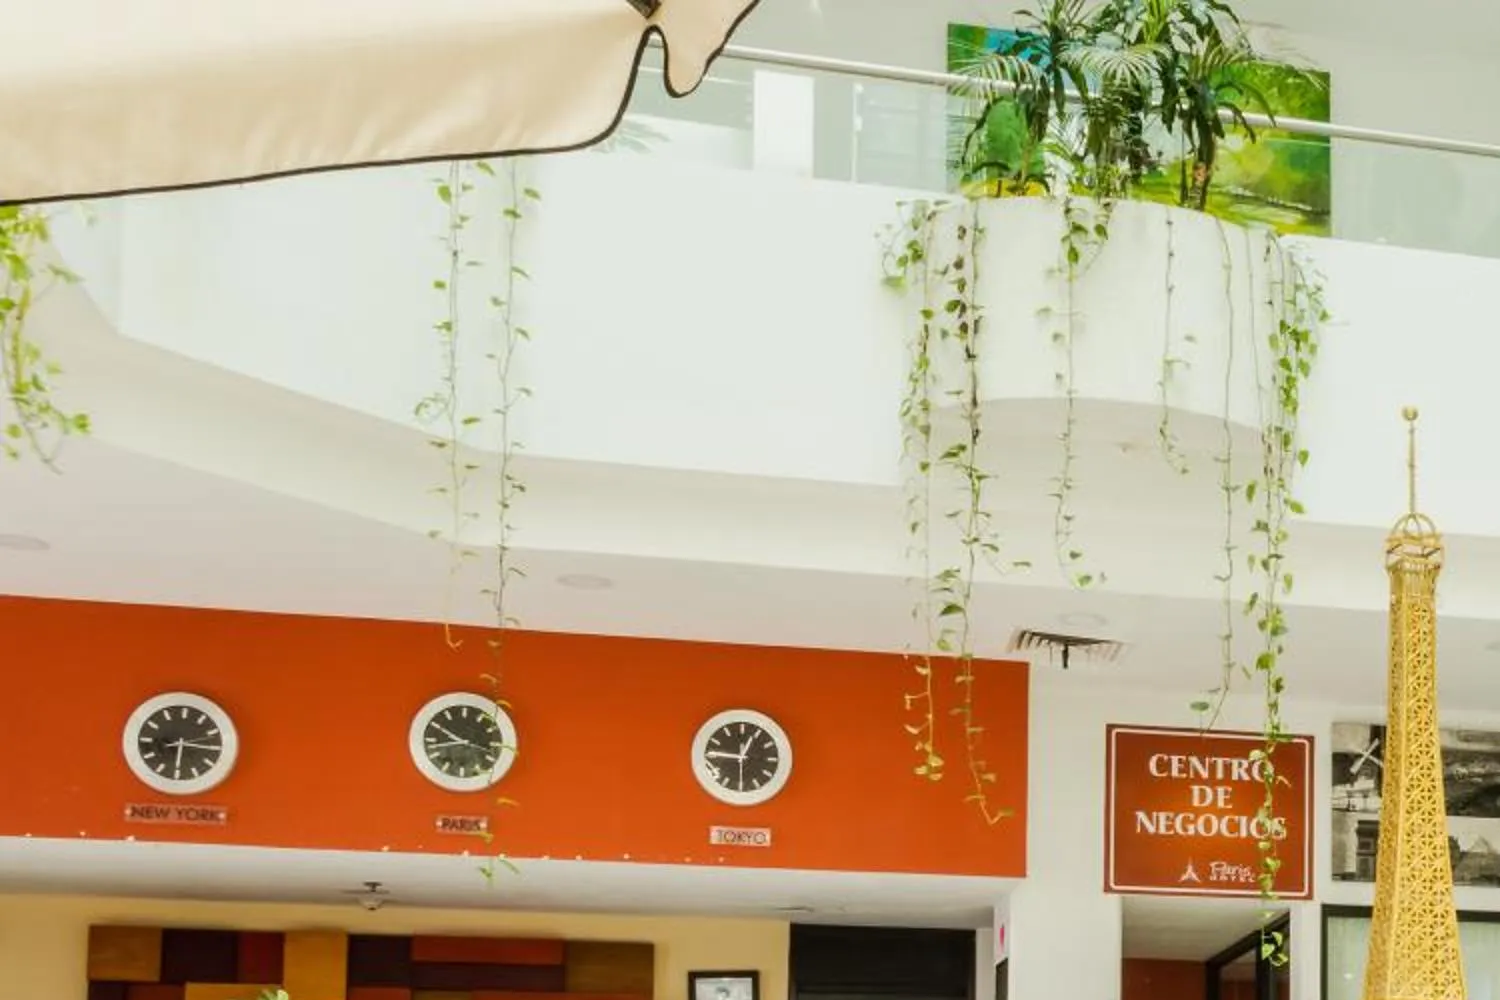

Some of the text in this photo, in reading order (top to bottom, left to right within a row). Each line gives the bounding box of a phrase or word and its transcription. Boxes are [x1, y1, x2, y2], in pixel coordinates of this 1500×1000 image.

[1149, 753, 1275, 783] CENTRO
[1191, 785, 1233, 808] DE
[131, 806, 221, 821] NEW YORK
[716, 829, 766, 845] TOKYO
[1136, 811, 1287, 840] NEGOCIOS
